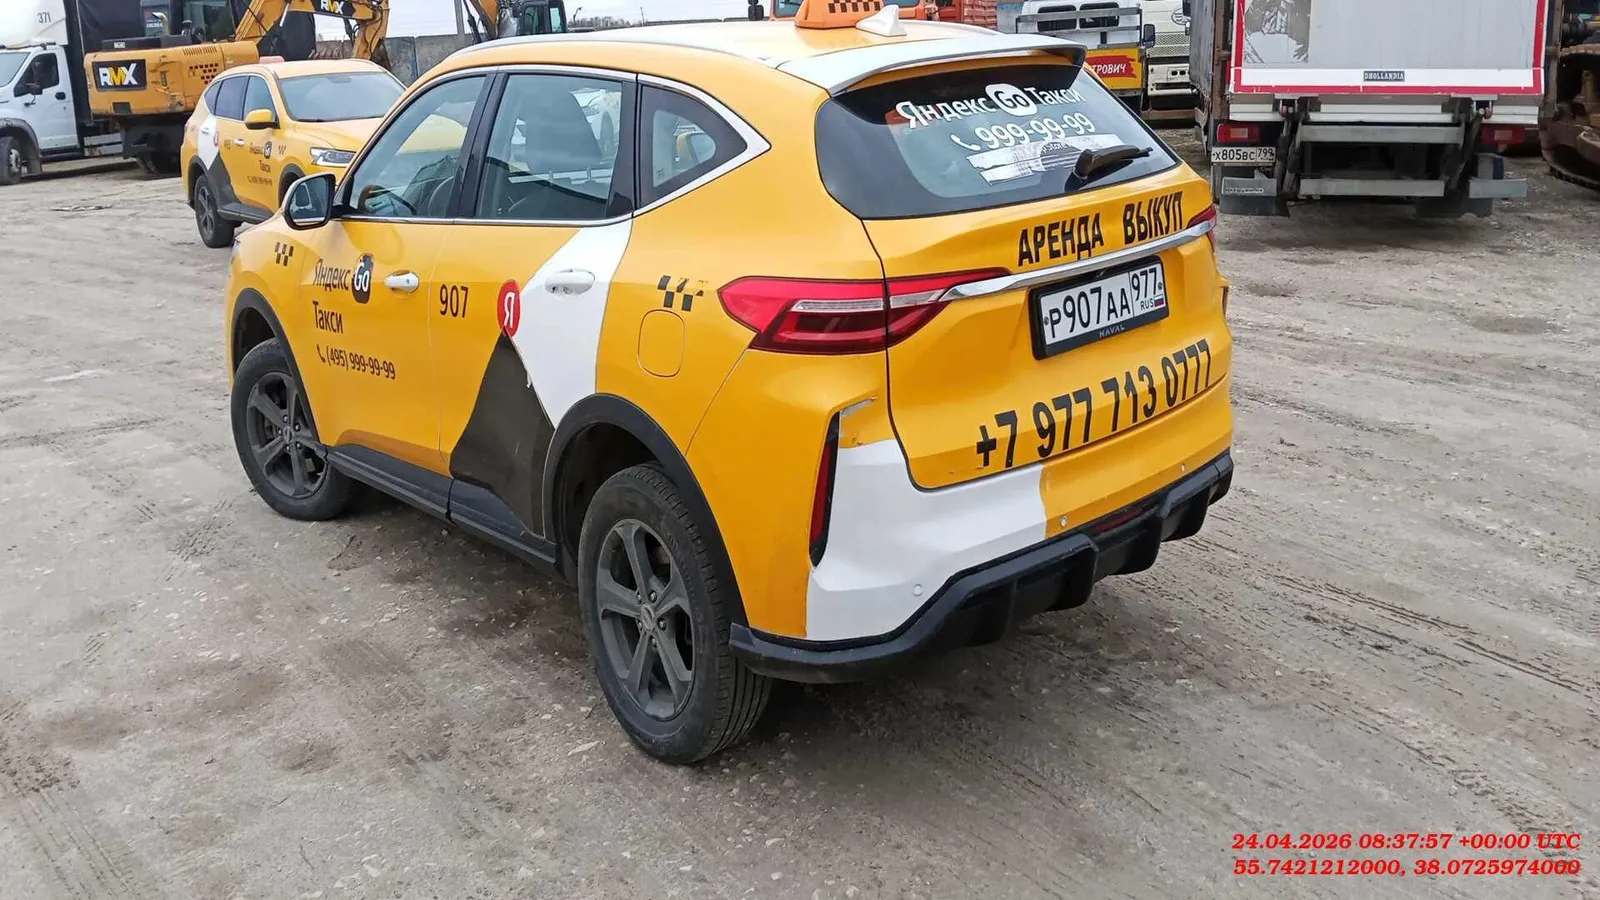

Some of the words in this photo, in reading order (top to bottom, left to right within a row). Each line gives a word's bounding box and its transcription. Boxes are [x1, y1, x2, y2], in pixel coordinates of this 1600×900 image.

[37, 12, 51, 23] 371
[99, 62, 138, 86] RMX
[1364, 71, 1404, 80] DHOLLANDIA
[895, 100, 998, 129] Яндекс
[1024, 87, 1086, 106] Такси
[974, 112, 1096, 150] 999-99-99
[1018, 212, 1104, 266] АРЕНДА
[1122, 191, 1184, 245] ВЫКУП
[312, 258, 351, 292] Яндекс
[312, 300, 344, 334] Такси
[439, 284, 469, 318] 907
[1049, 286, 1131, 338] Р907АА
[1131, 267, 1158, 301] 977
[1140, 298, 1154, 311] RUS
[1099, 324, 1125, 338] HAVAL
[326, 348, 349, 371] (495)
[349, 353, 396, 380] 999-99-99
[976, 410, 1018, 468] +7
[1032, 387, 1092, 458] 977
[1101, 365, 1156, 432] 713
[1161, 339, 1211, 407] 0777
